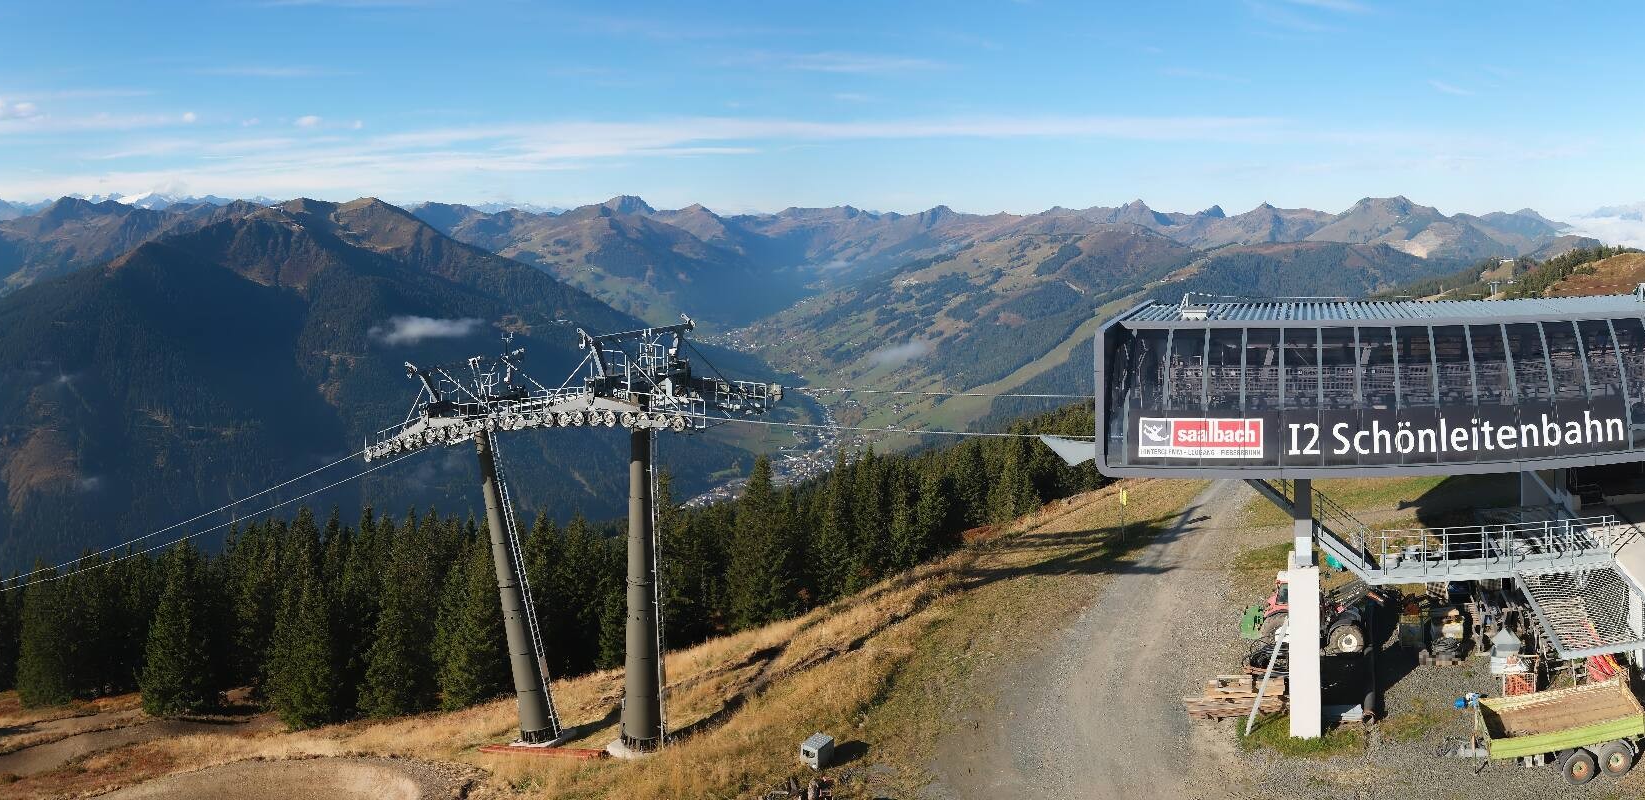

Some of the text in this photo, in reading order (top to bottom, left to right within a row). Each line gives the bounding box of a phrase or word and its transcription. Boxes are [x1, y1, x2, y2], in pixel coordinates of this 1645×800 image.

[1178, 420, 1255, 442] saalbach
[1288, 411, 1625, 455] I2 Schönleitenbahn
